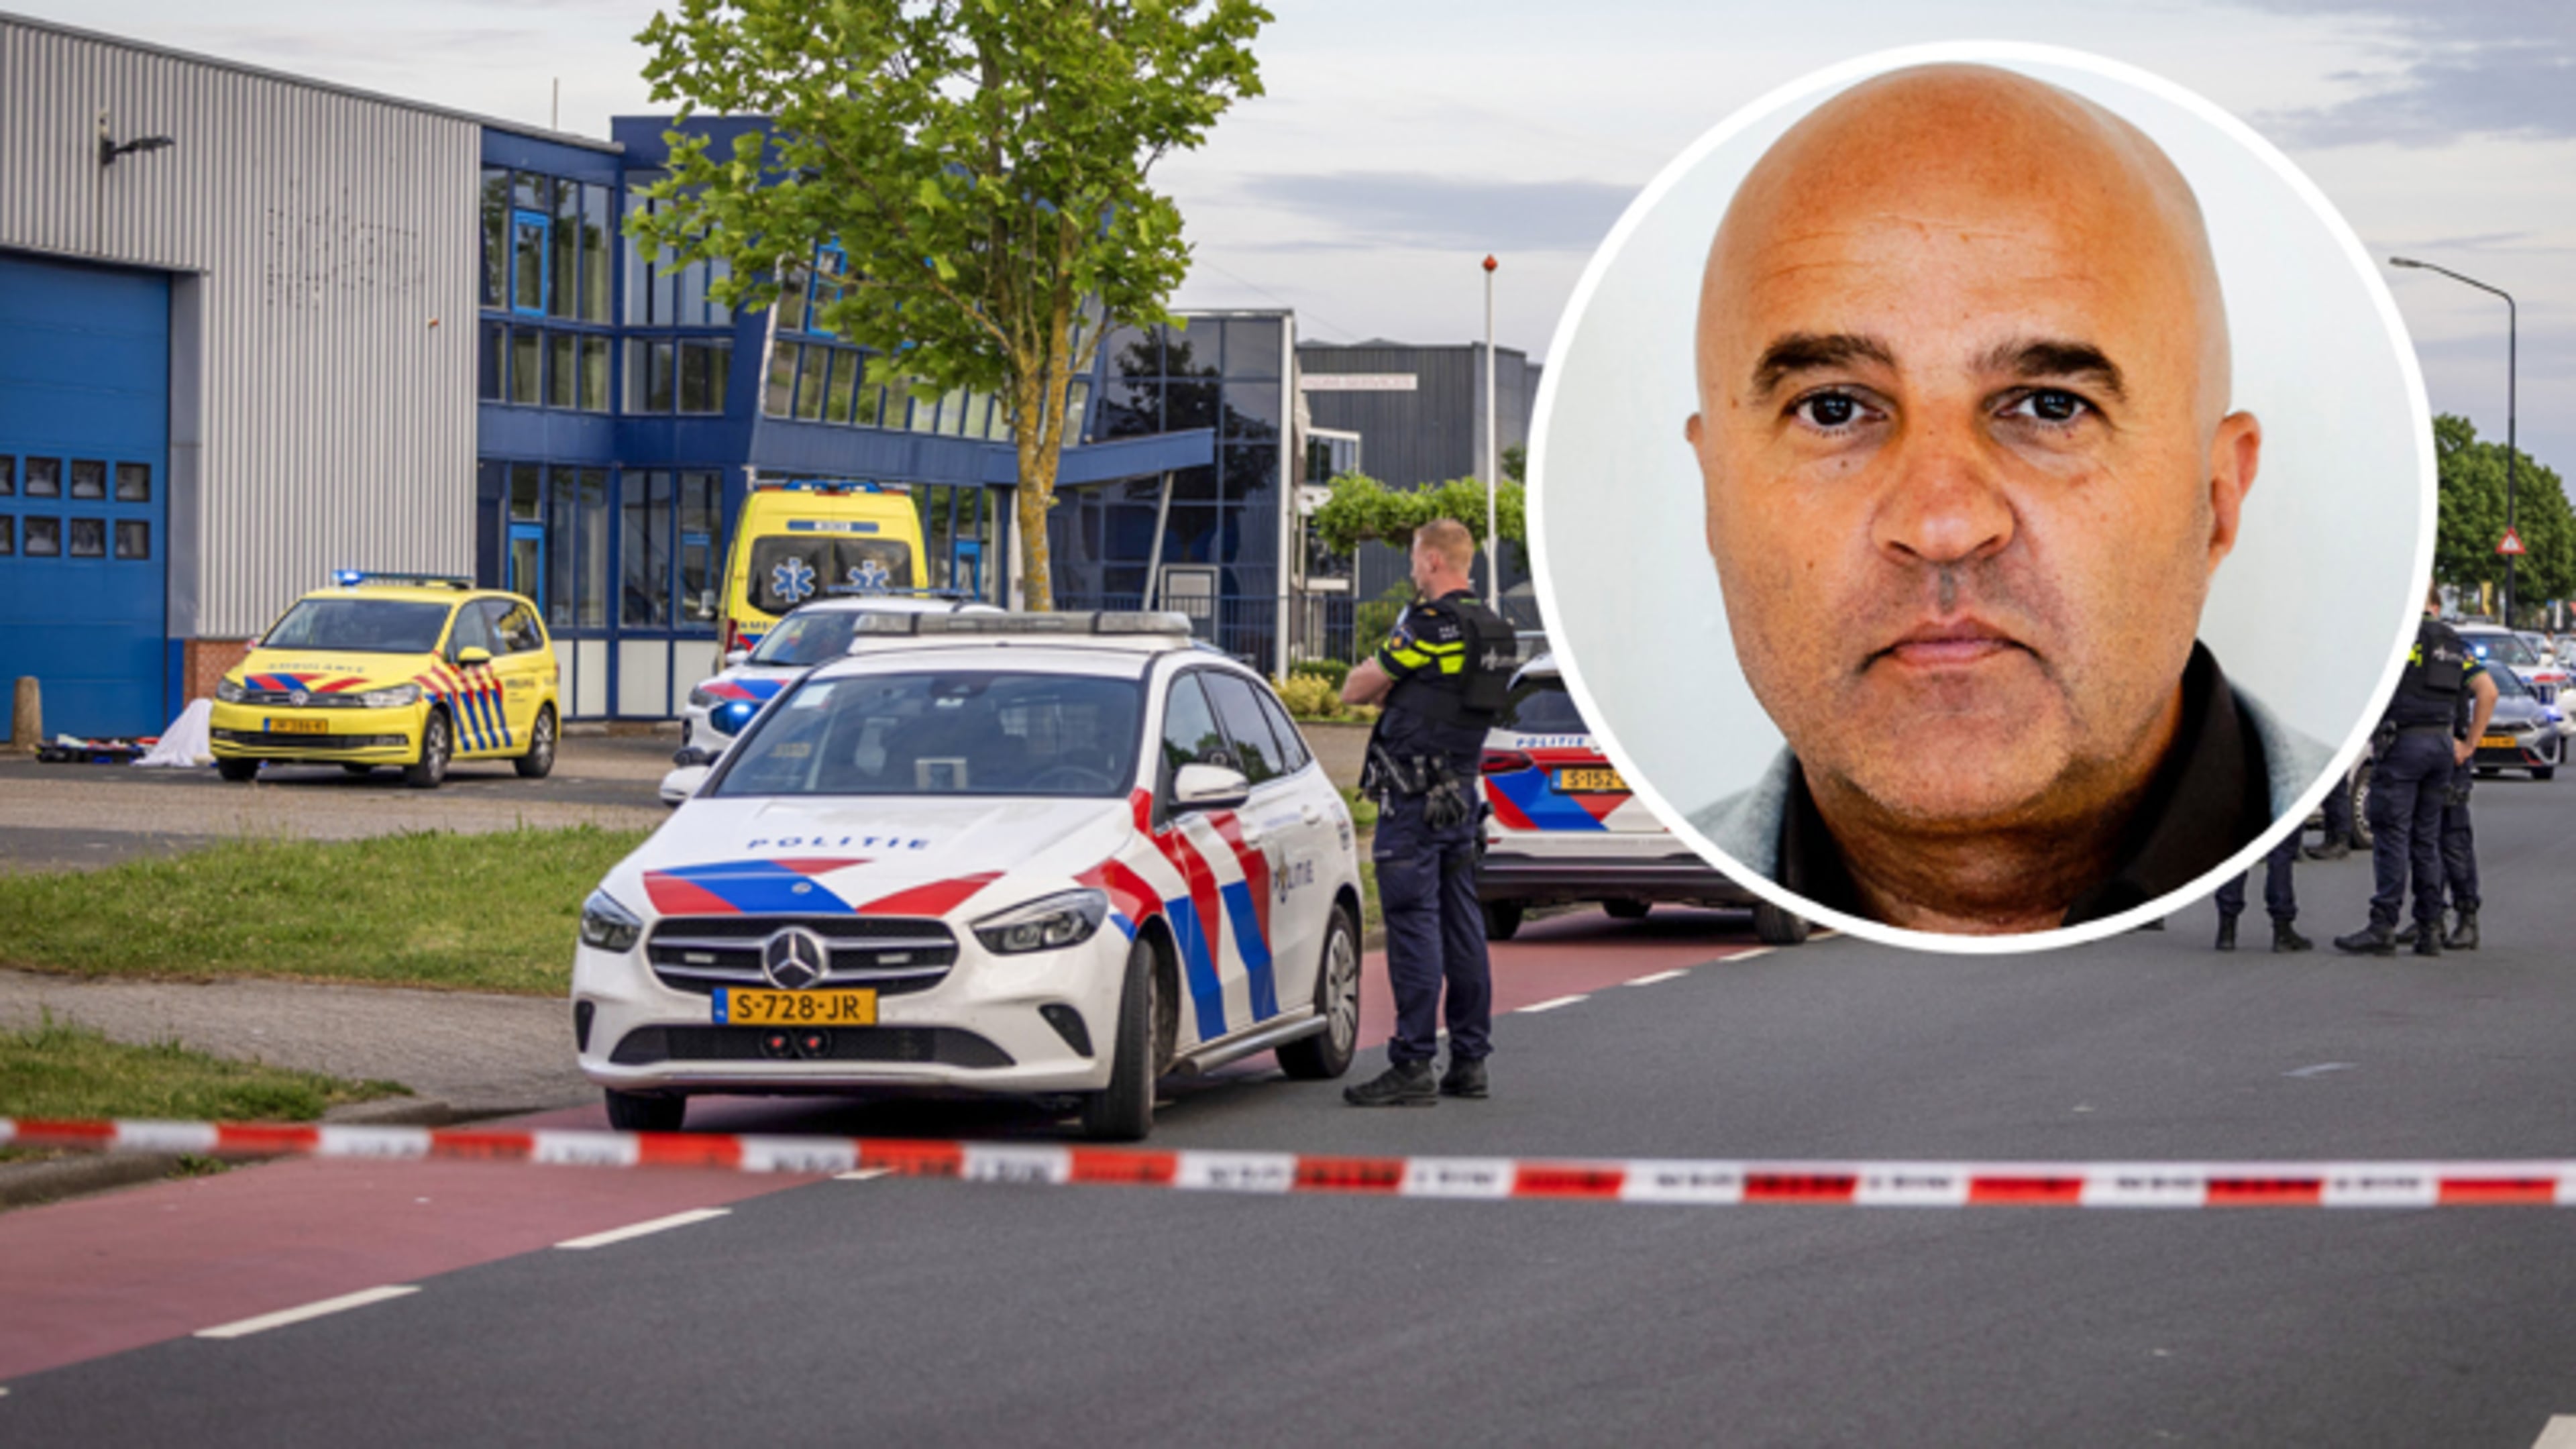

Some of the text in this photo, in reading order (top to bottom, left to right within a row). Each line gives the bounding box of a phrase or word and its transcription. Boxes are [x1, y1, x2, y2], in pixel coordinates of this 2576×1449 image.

[1516, 736, 1585, 748] POLITIE
[747, 835, 930, 850] POLITIE
[737, 994, 860, 1020] S-728-JR
